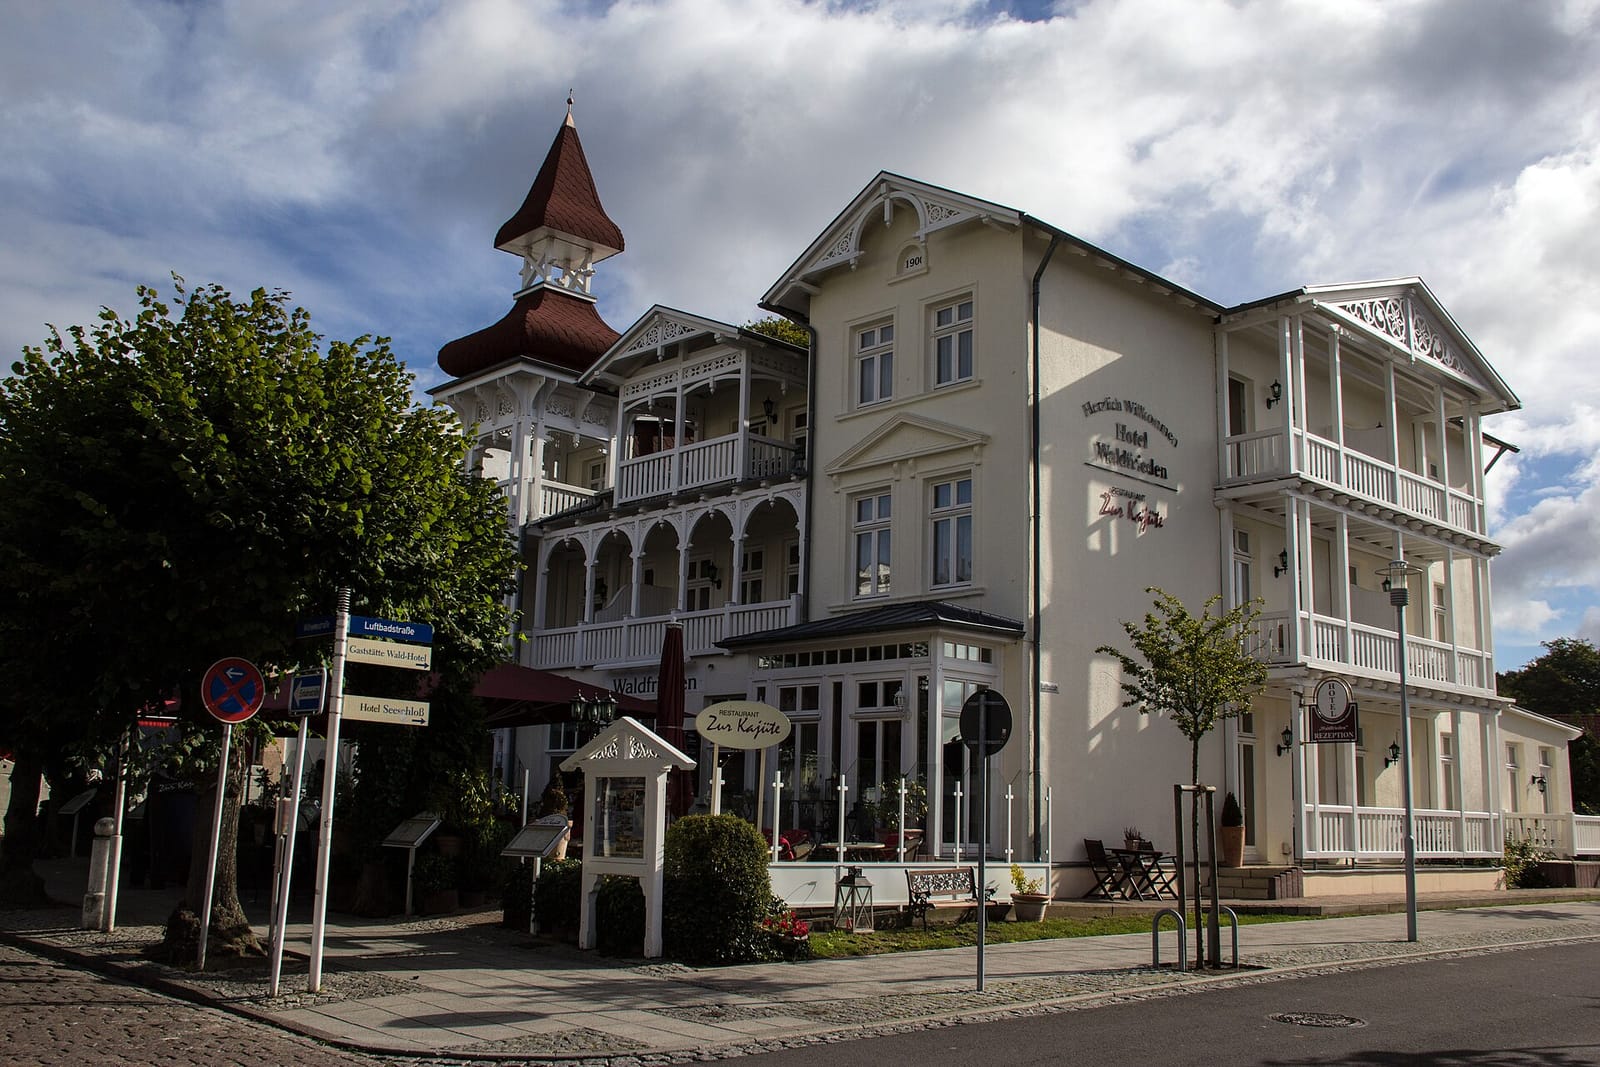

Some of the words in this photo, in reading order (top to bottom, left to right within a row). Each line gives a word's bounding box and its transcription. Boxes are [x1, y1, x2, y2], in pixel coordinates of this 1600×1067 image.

[1081, 397, 1122, 418] Herzlich
[1123, 400, 1178, 448] Willkommen
[1115, 422, 1148, 449] Hotel
[1094, 441, 1168, 479] Waldfrieden
[1099, 492, 1124, 518] Zur
[364, 621, 415, 636] Luftbadstraße
[349, 645, 385, 657] Gaststätte
[387, 650, 427, 662] Wald-Hotel
[360, 703, 380, 713] Hotel
[383, 705, 425, 717] Seeschloß
[1328, 683, 1337, 717] HOTEL
[719, 709, 760, 718] RESTAURANT
[706, 715, 733, 732] Zur
[737, 717, 781, 740] Kajüte
[1314, 731, 1354, 739] REZEPTION
